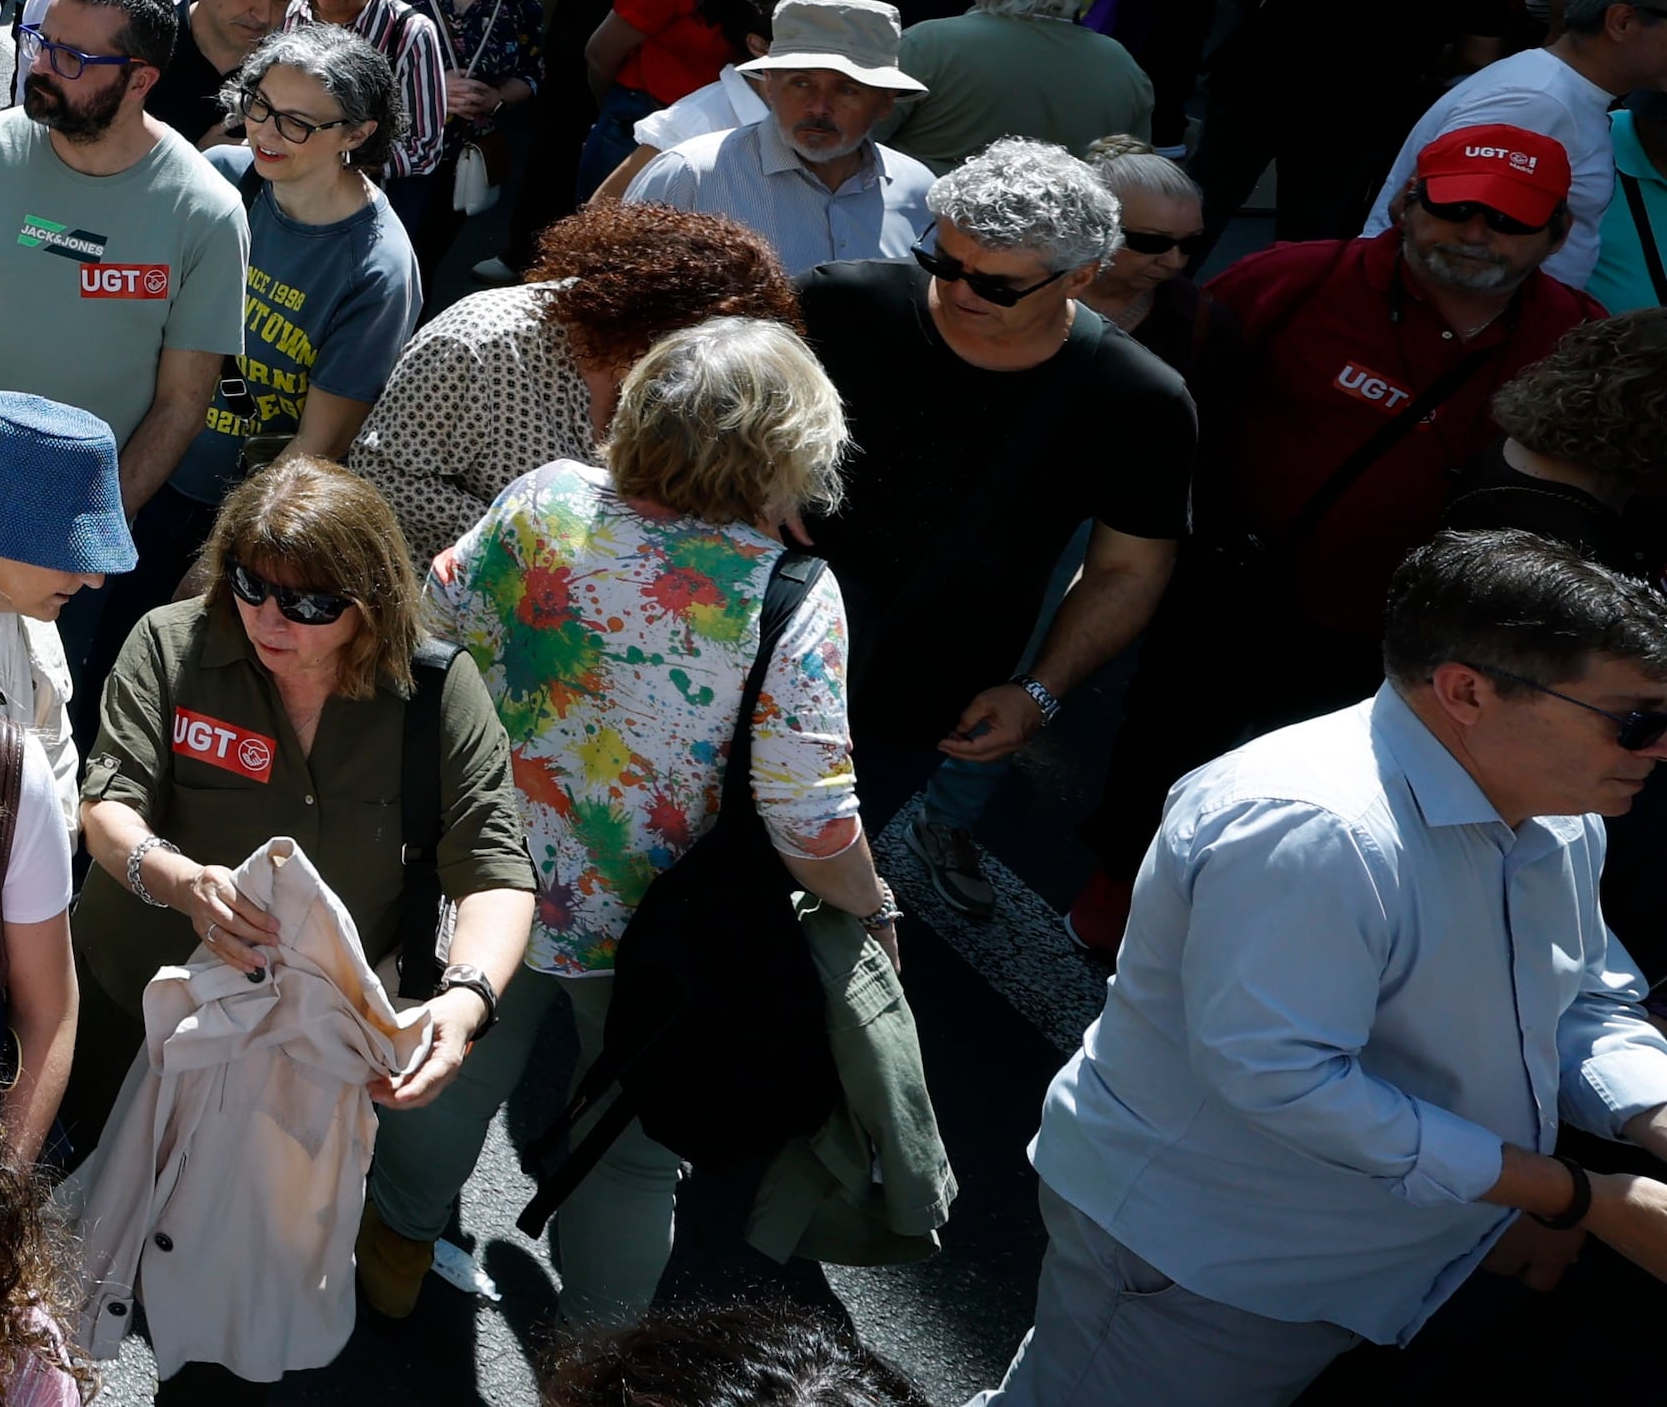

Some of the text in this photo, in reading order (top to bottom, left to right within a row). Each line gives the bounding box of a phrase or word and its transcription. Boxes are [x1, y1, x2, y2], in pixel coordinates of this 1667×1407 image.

[1465, 146, 1509, 161] UGT
[20, 223, 105, 257] JACK&JONES
[81, 269, 140, 294] UGT
[268, 280, 307, 312] 1998
[1338, 364, 1409, 411] UGT
[173, 714, 237, 761] UGT
